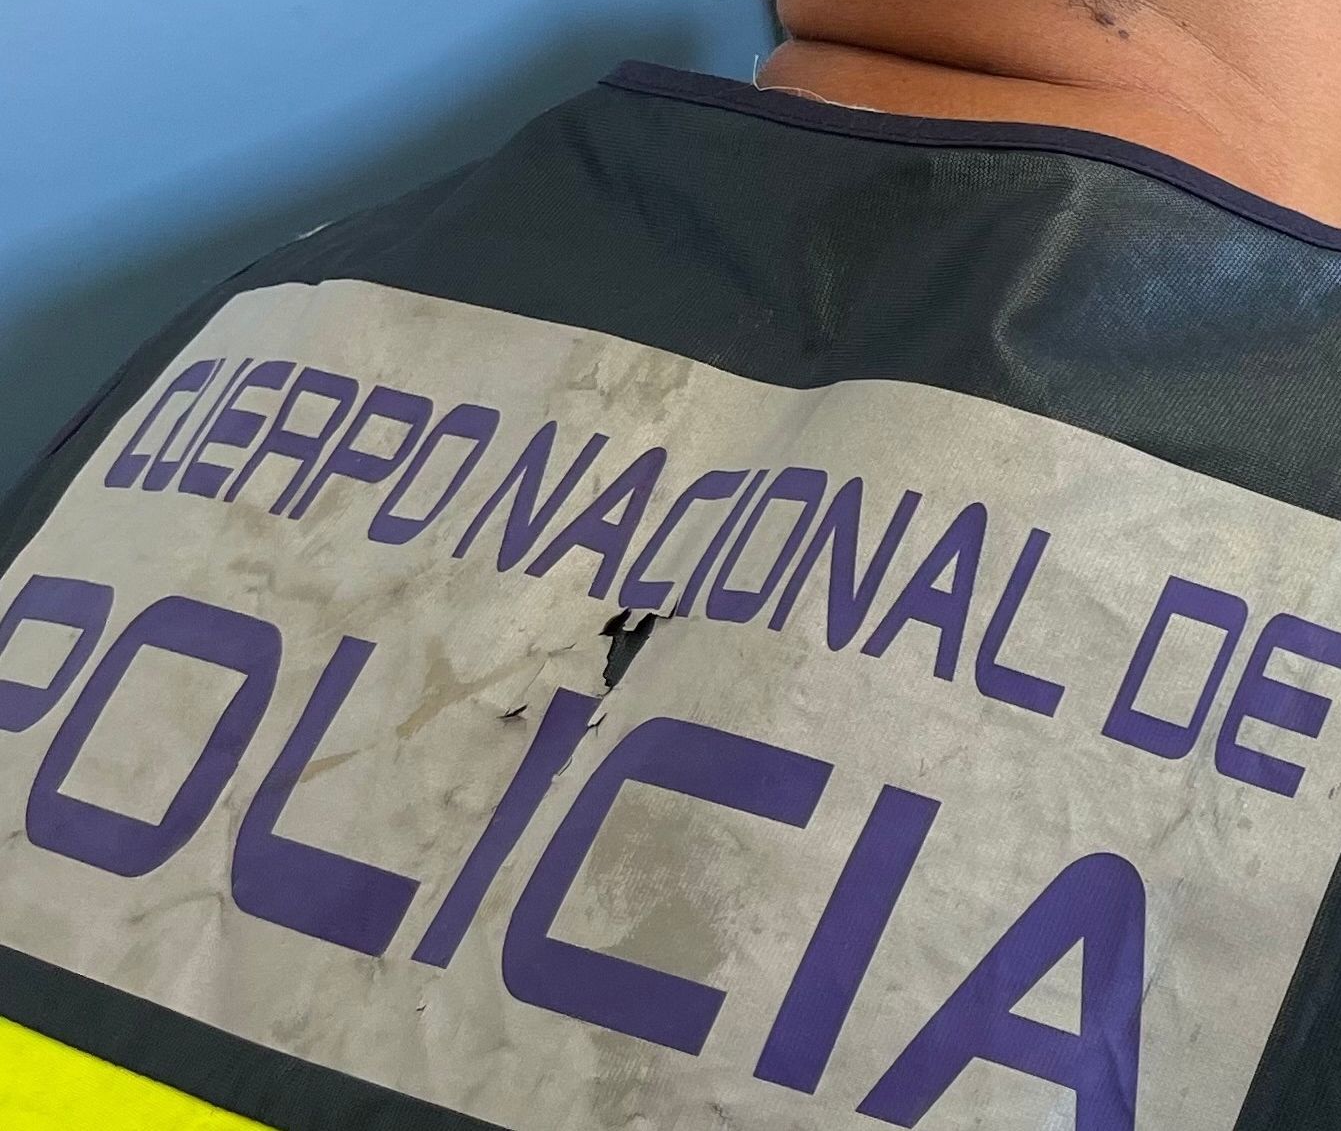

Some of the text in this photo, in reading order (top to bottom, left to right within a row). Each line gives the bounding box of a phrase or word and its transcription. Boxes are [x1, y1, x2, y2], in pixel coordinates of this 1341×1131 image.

[104, 357, 503, 545] CUERPO
[463, 418, 1066, 718] NACIONAL
[0, 573, 1147, 1131] POLICIA
